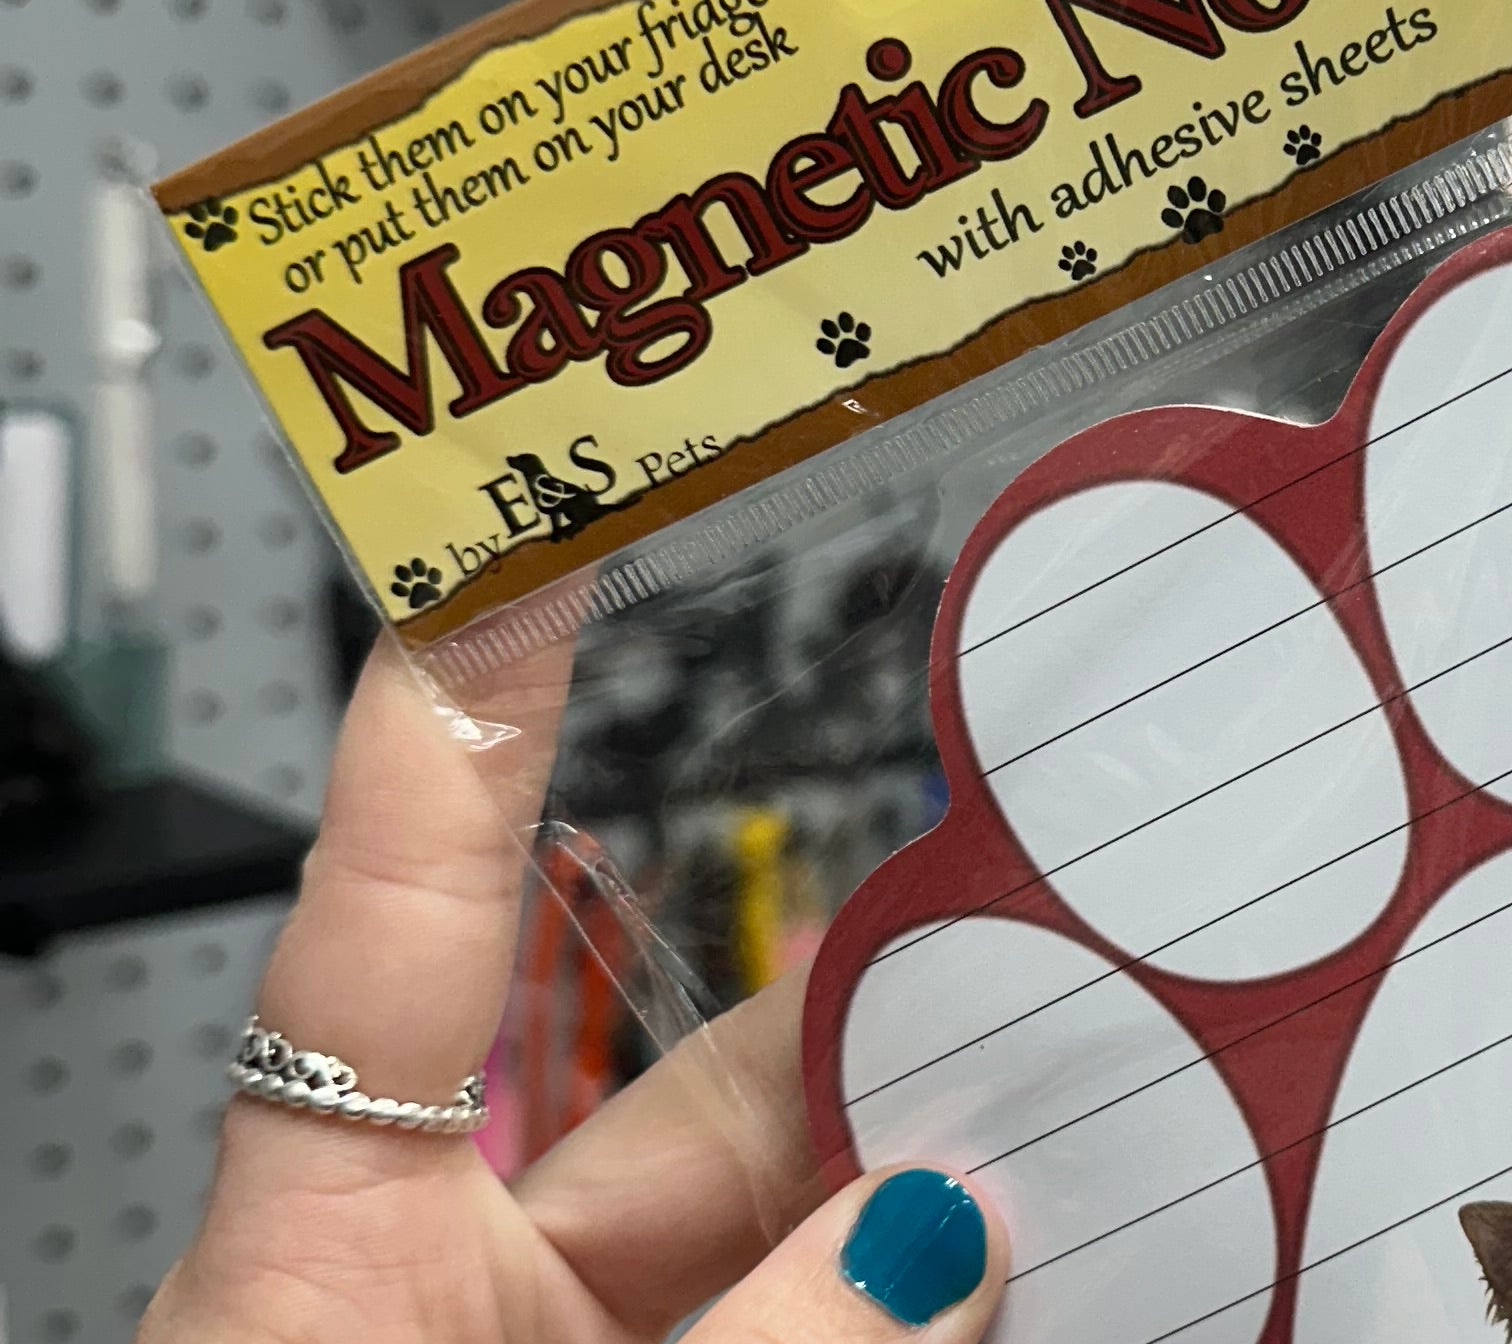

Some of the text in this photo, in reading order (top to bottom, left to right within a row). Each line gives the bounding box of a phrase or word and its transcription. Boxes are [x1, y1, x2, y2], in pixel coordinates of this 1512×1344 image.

[249, 159, 362, 246] Stick
[357, 135, 476, 192] them
[479, 89, 539, 135] on
[534, 36, 632, 125] your
[263, 36, 1050, 476] Magnetic
[285, 11, 799, 293] or put them on your desk
[916, 5, 1439, 278] with adhesive sheets
[445, 532, 501, 575] by
[635, 434, 724, 487] Pets
